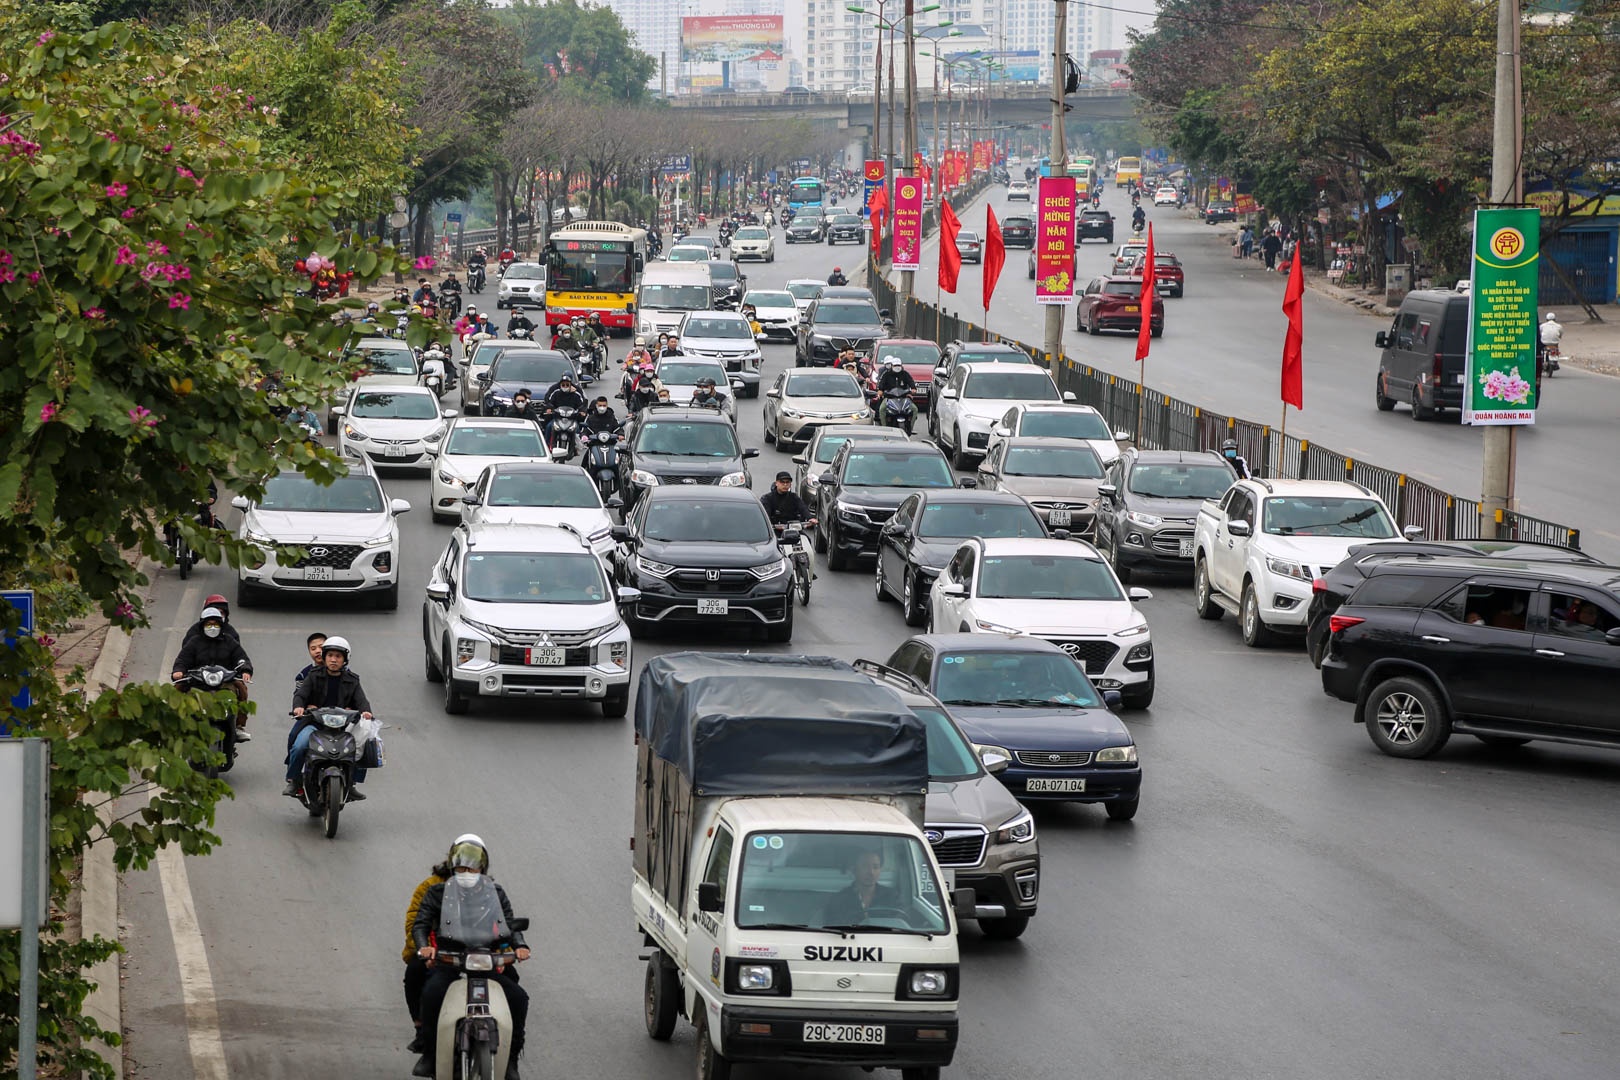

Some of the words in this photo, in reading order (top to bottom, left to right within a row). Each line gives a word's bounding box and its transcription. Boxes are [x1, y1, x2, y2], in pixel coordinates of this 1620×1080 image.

[1044, 196, 1070, 207] CHÚC
[1044, 210, 1070, 222] MỪNG
[1046, 225, 1066, 236] NĂM
[1048, 240, 1064, 250] MỚI
[1474, 412, 1492, 421] QUẬN
[804, 946, 883, 962] SUZUKI
[806, 1025, 883, 1042] 29C-206.98
